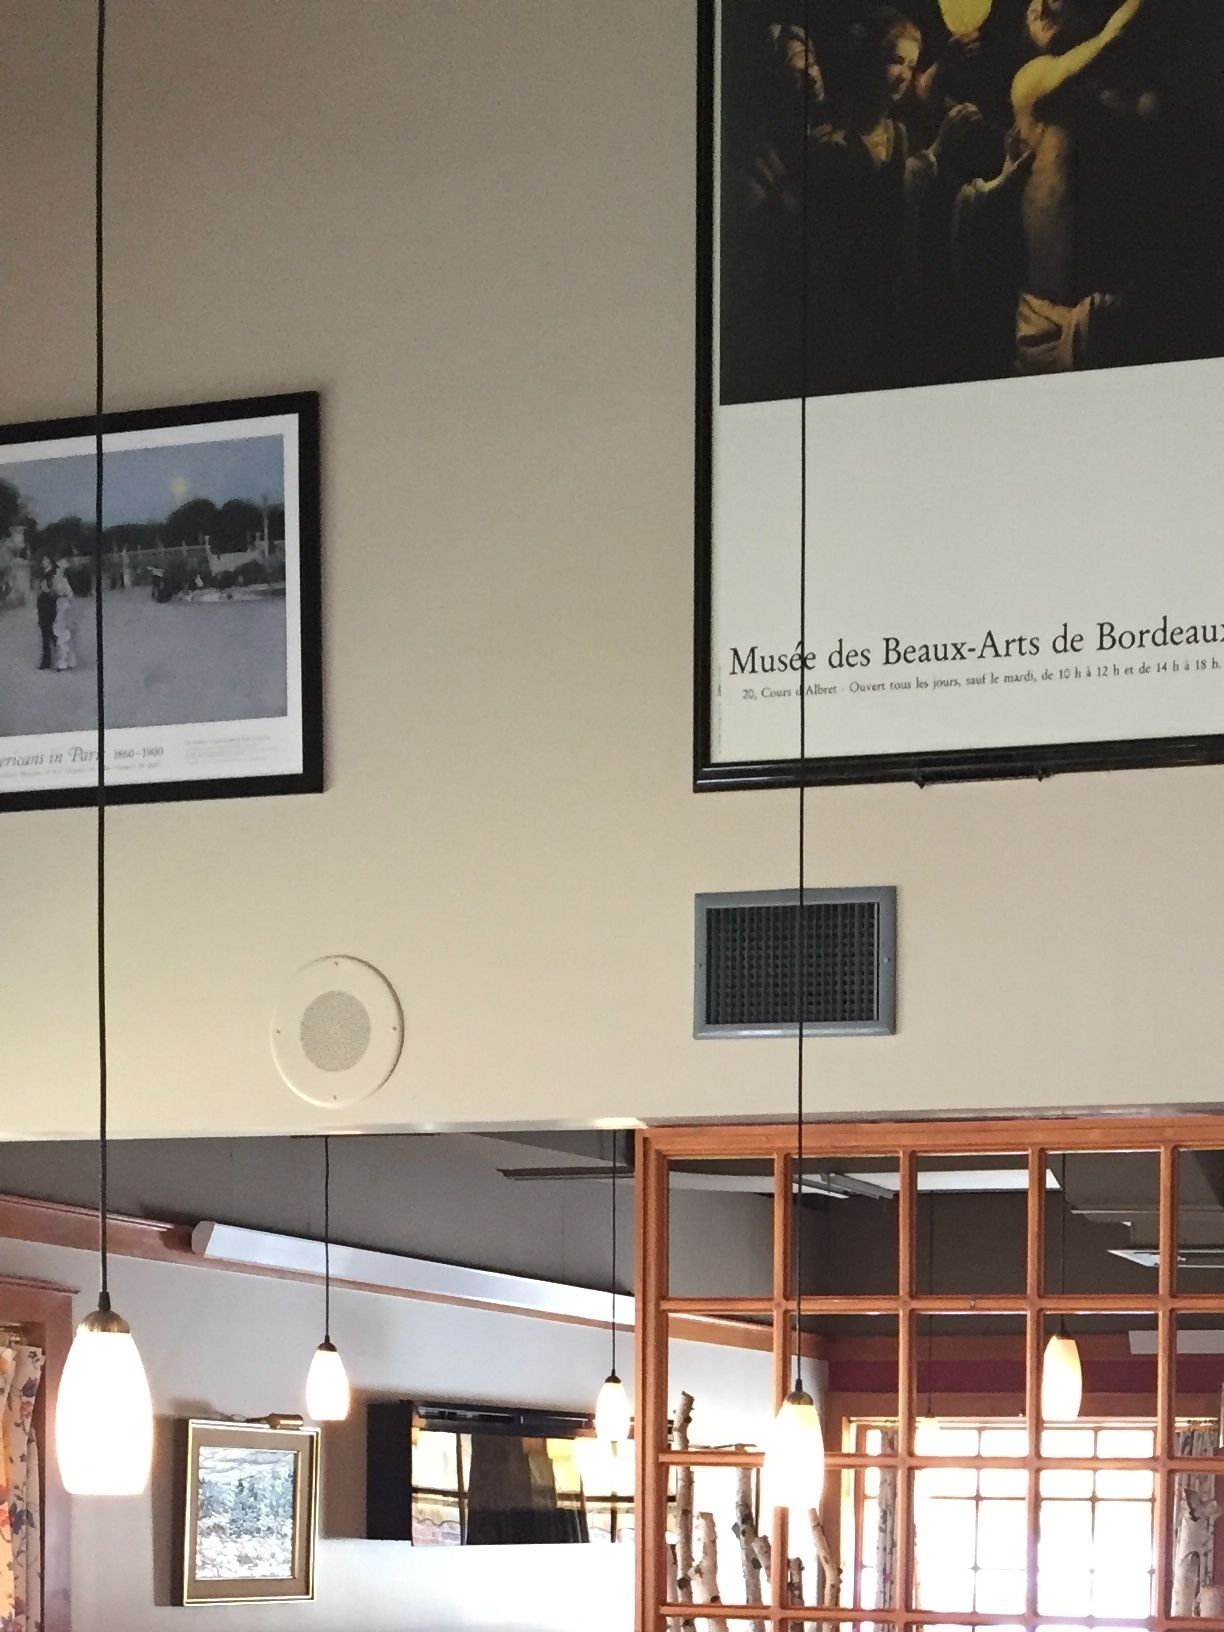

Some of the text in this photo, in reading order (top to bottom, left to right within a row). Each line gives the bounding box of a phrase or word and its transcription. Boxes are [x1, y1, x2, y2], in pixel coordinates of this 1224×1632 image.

[729, 640, 816, 675] Musée
[828, 638, 871, 669] des
[883, 630, 1040, 665] Beaux-Arts
[1052, 623, 1084, 654] de
[761, 687, 791, 698] Cours
[850, 680, 885, 693] Ouvert
[890, 679, 911, 690] tous
[916, 677, 928, 689] les
[933, 676, 961, 690] jours,
[966, 674, 986, 686] sauf
[991, 672, 1000, 684] le
[1003, 671, 1037, 684] mardi,
[1041, 668, 1053, 680] de
[1059, 668, 1070, 679] 10
[1074, 666, 1081, 678] h
[1086, 665, 1092, 677] à
[1097, 665, 1108, 677] 12
[1113, 664, 1120, 676] h
[1125, 665, 1134, 675] et
[1138, 662, 1151, 674] de
[1156, 661, 1168, 673] 14
[1172, 660, 1179, 672] h
[1195, 659, 1207, 670] 18
